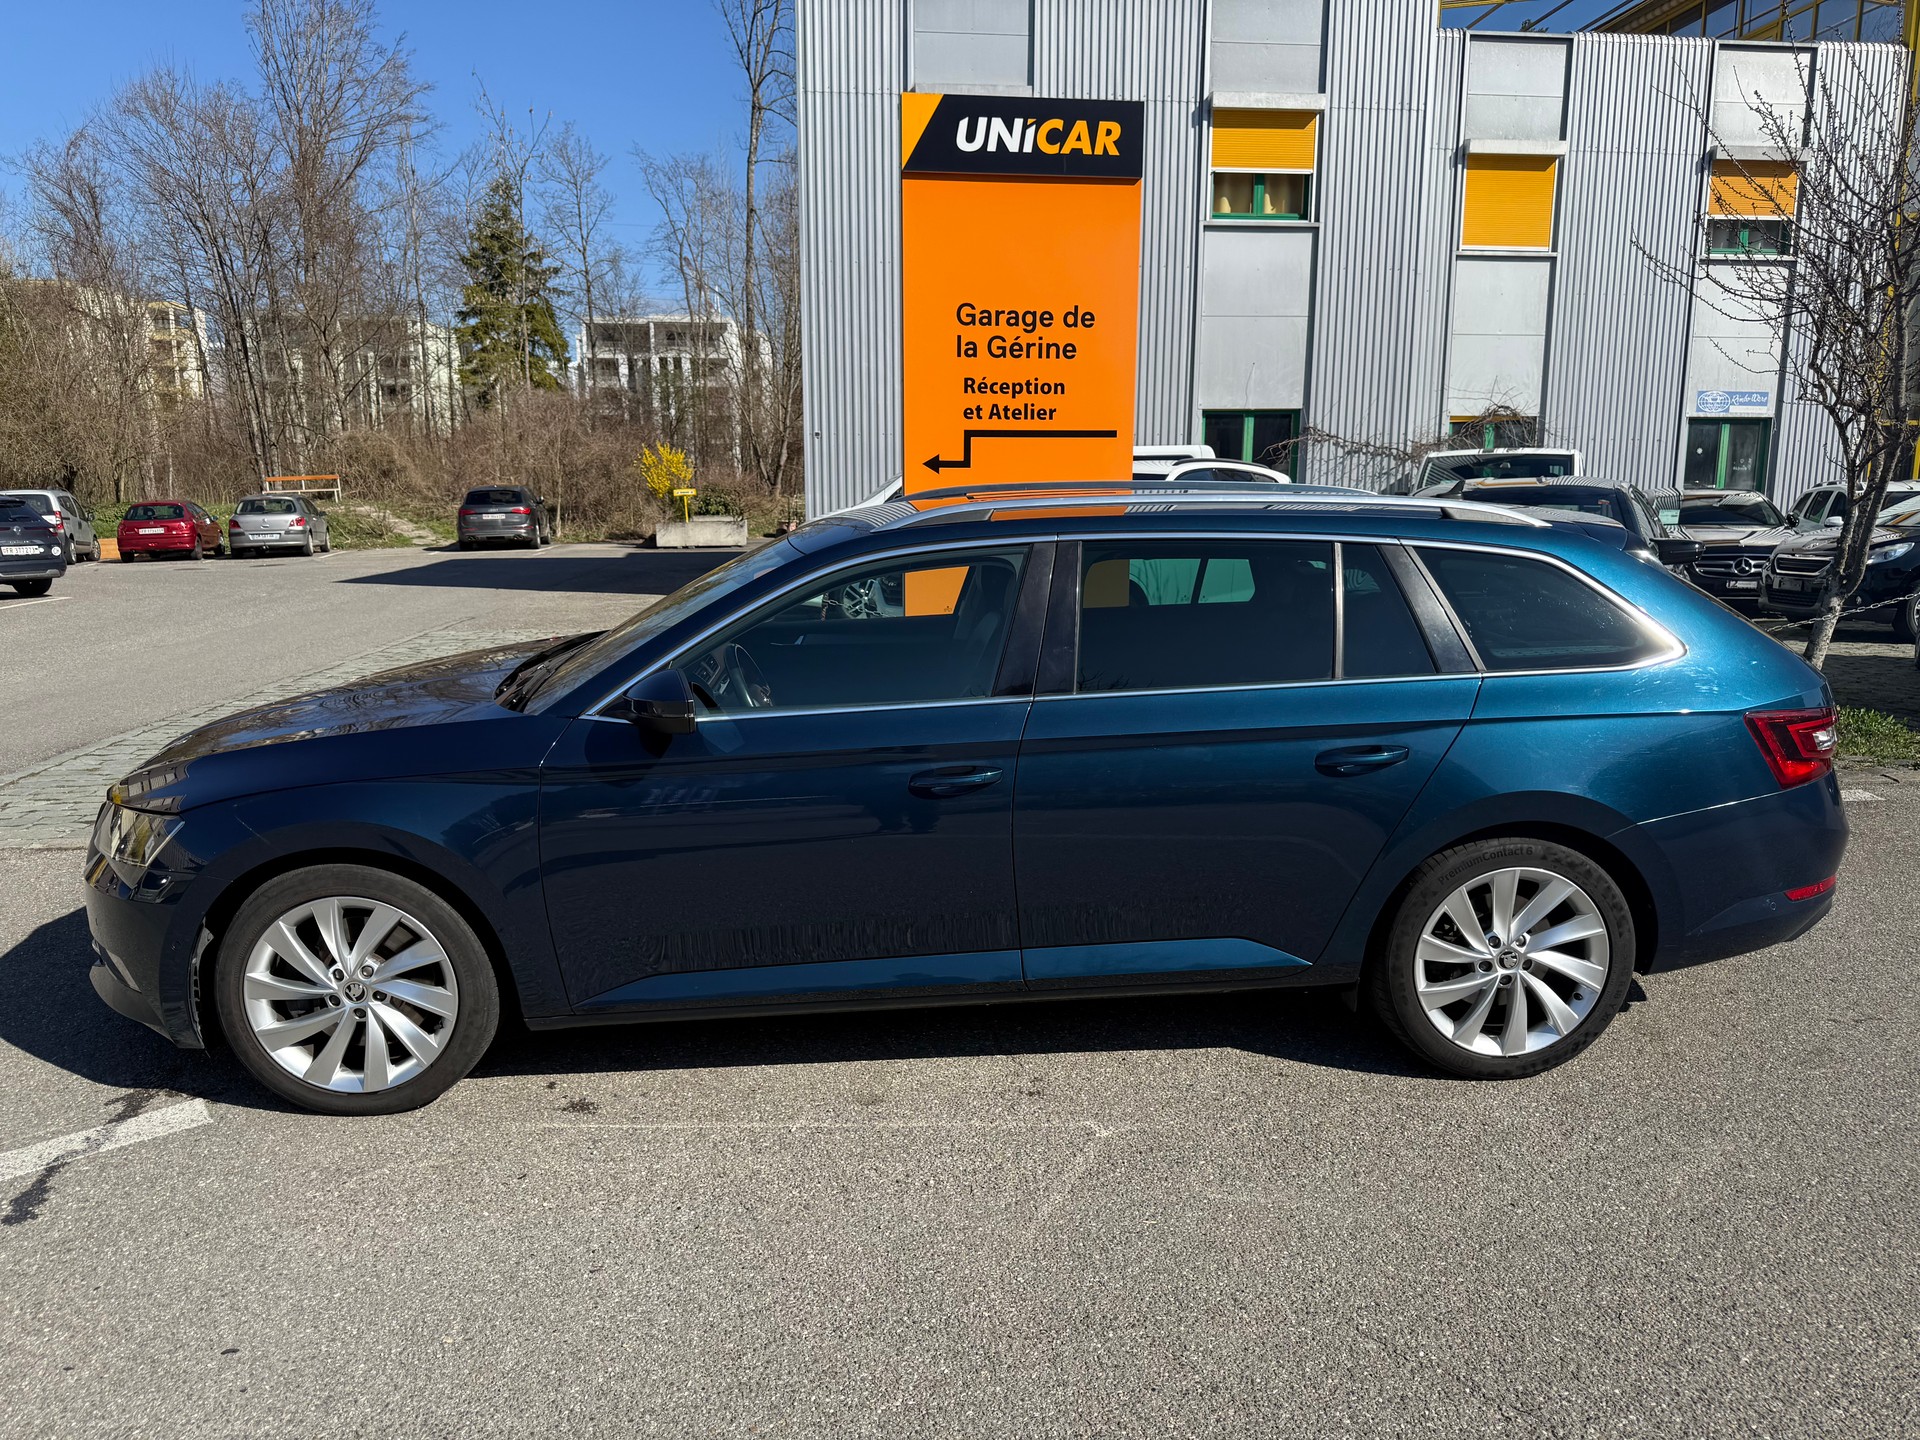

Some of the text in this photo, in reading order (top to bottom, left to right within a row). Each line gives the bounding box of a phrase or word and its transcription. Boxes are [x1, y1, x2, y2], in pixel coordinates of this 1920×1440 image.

[957, 303, 1095, 333] Garage de
[957, 335, 1076, 359] la Gérine
[964, 377, 1064, 399] Réception
[964, 403, 1056, 420] et Atelier
[1438, 847, 1524, 885] PremiumContact
